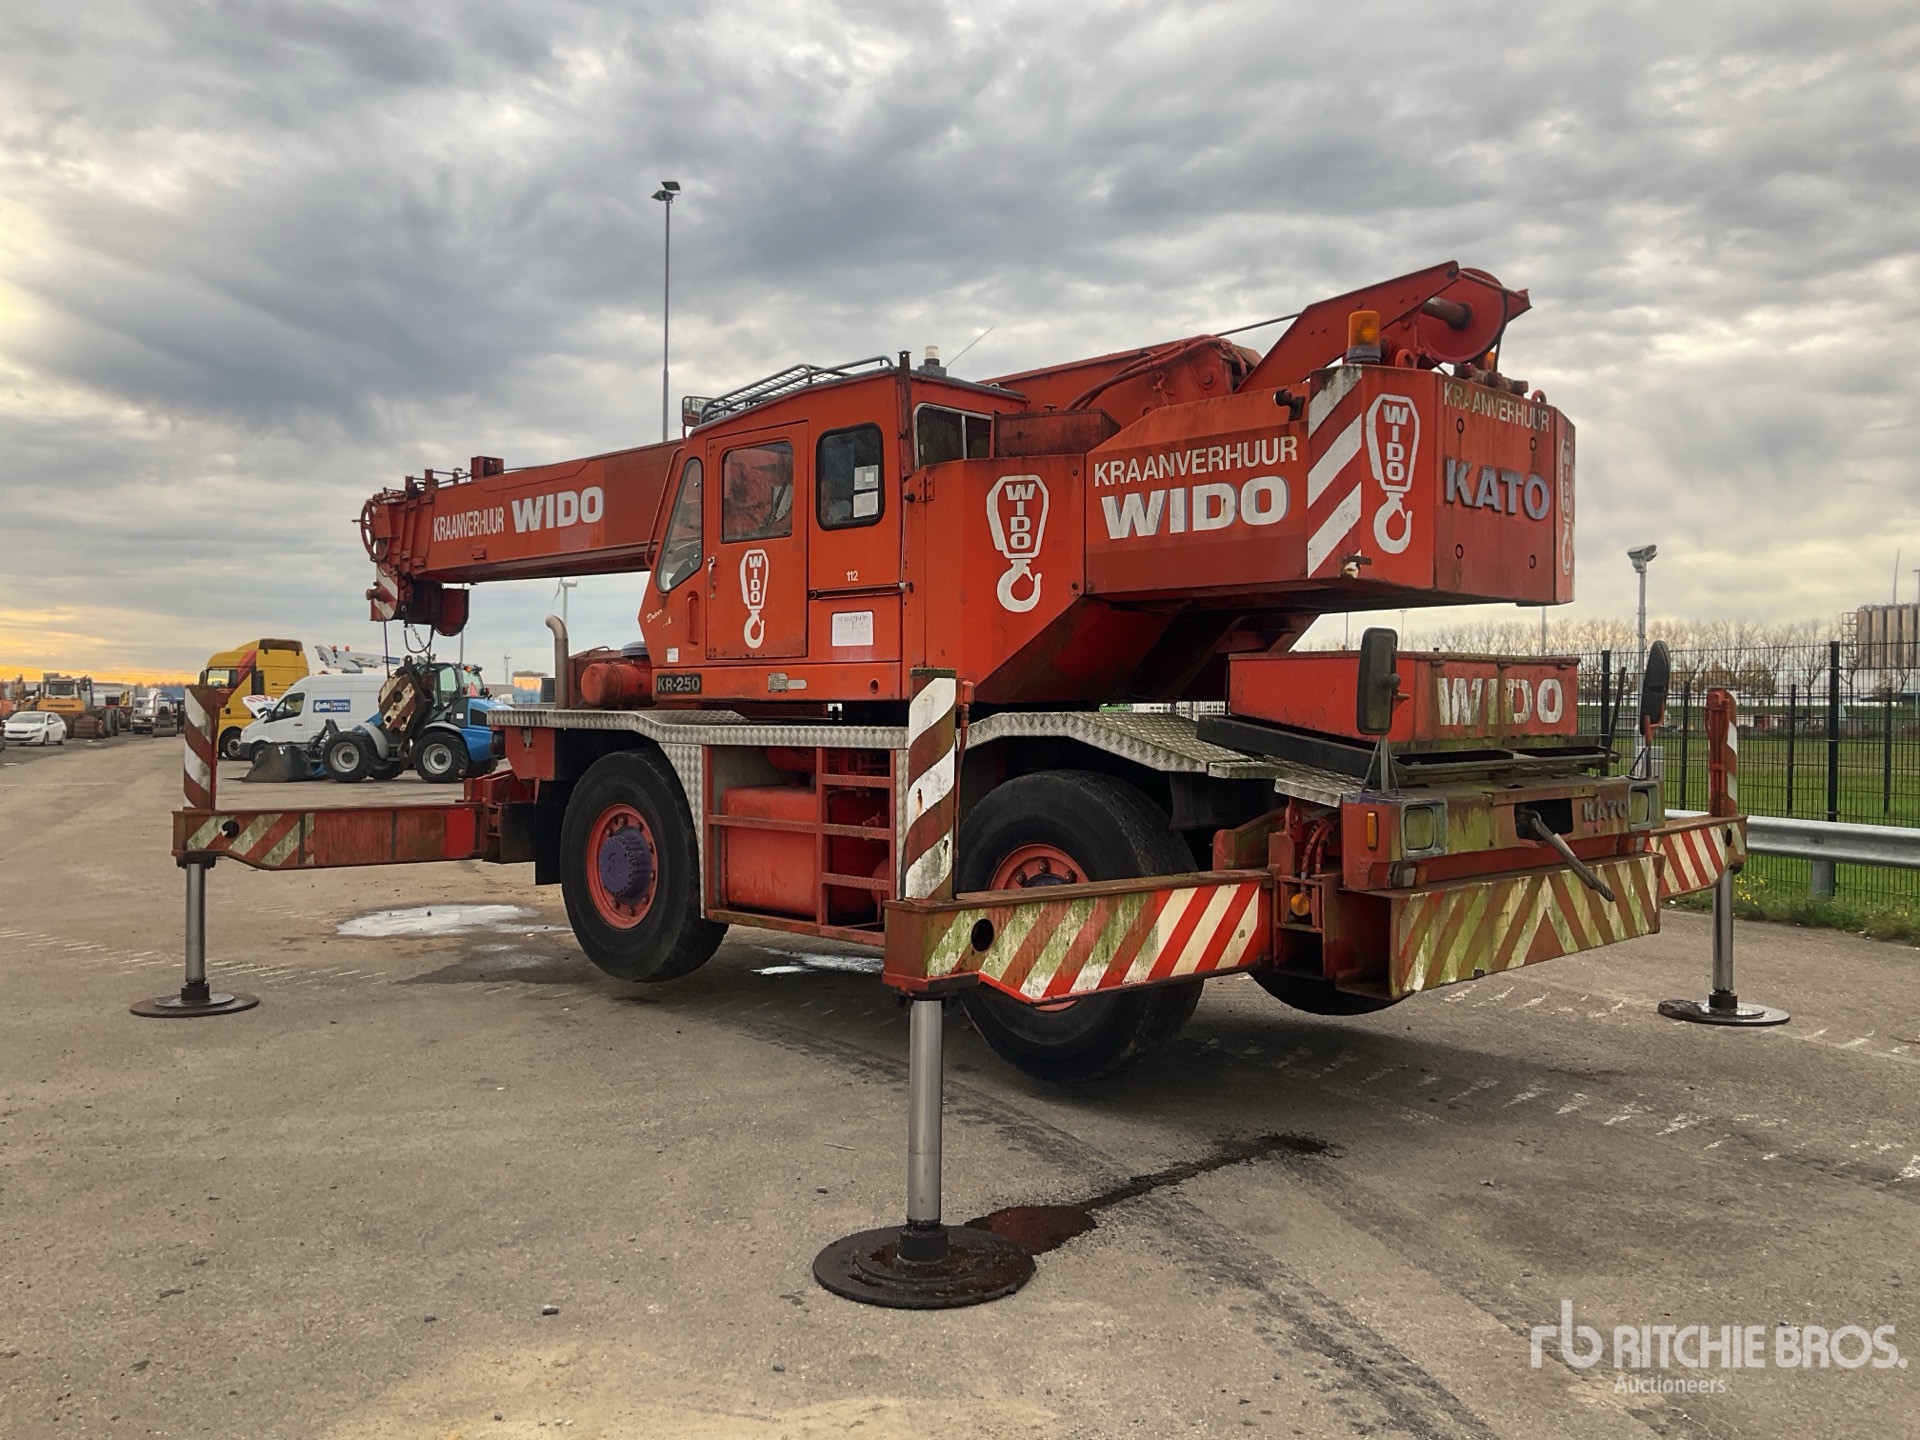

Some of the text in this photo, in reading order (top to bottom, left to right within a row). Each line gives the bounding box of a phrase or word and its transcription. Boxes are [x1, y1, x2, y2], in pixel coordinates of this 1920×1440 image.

[1443, 381, 1550, 433] KRAANVERHUUR
[1093, 435, 1298, 487] KRAANVERHUUR
[1382, 404, 1410, 481] WIDO
[433, 486, 604, 542] KRAANVERHUUR WIDO
[1101, 475, 1290, 540] WIDO
[1444, 457, 1551, 521] KATO
[1005, 484, 1034, 549] WIDO
[748, 556, 763, 604] WIDO
[846, 570, 859, 582] 112
[1437, 678, 1563, 726] WIDO
[1582, 800, 1627, 822] KATO
